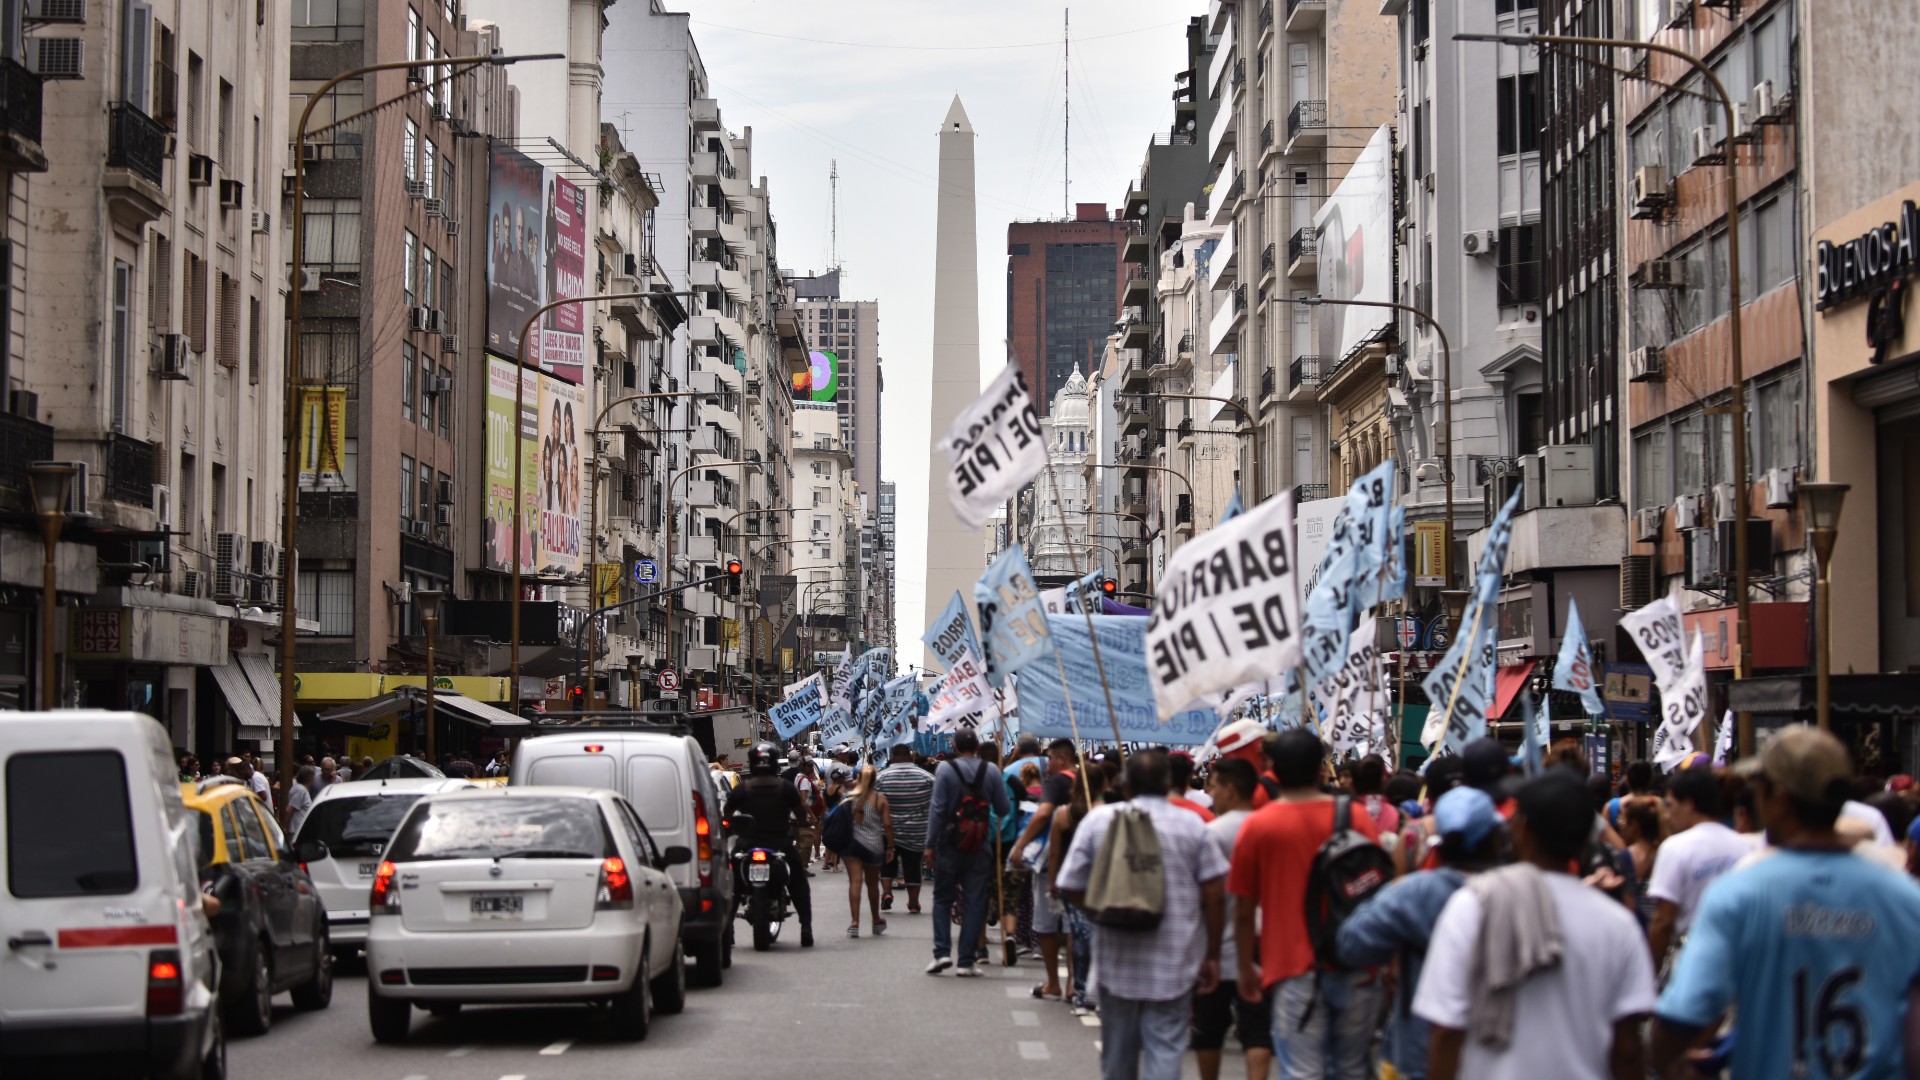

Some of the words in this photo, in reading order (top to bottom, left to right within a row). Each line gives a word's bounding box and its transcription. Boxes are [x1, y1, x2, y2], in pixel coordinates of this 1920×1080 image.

[1817, 222, 1896, 299] BUENOS
[557, 267, 583, 303] MARIDO
[488, 409, 508, 470] TOC
[542, 511, 580, 557] FALLADAS
[639, 563, 653, 580] E
[83, 612, 119, 625] HER
[83, 626, 119, 638] NAN
[83, 639, 119, 651] DEZ
[1792, 965, 1867, 1080] 16
